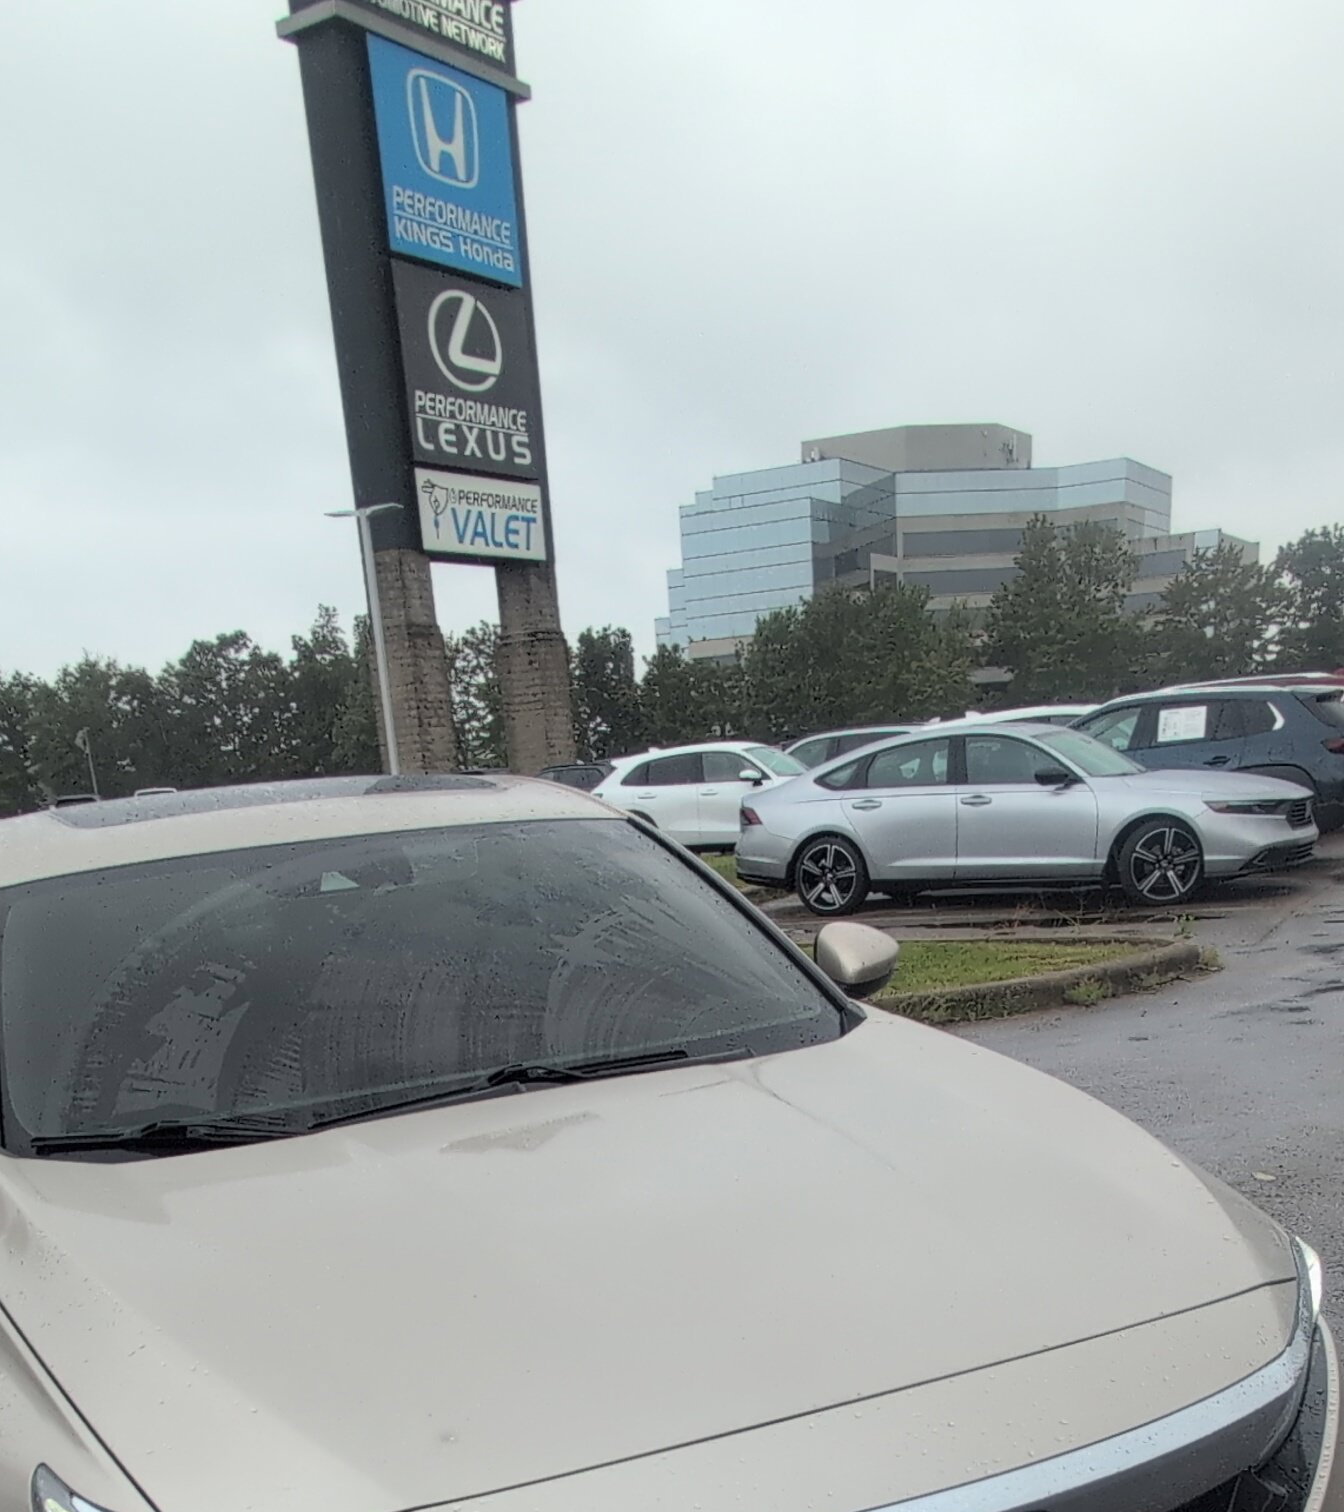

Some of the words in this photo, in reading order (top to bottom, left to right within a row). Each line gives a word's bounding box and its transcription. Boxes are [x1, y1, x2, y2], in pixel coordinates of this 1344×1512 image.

[440, 14, 506, 63] NETWORK
[392, 185, 511, 244] PERFORMANCE
[394, 215, 454, 253] KINGS
[460, 235, 515, 272] Honda
[415, 390, 527, 432] PERFORMANCE
[416, 417, 532, 465] LEXUS
[458, 489, 538, 514] PERFORMANCE
[450, 507, 537, 551] VALET
